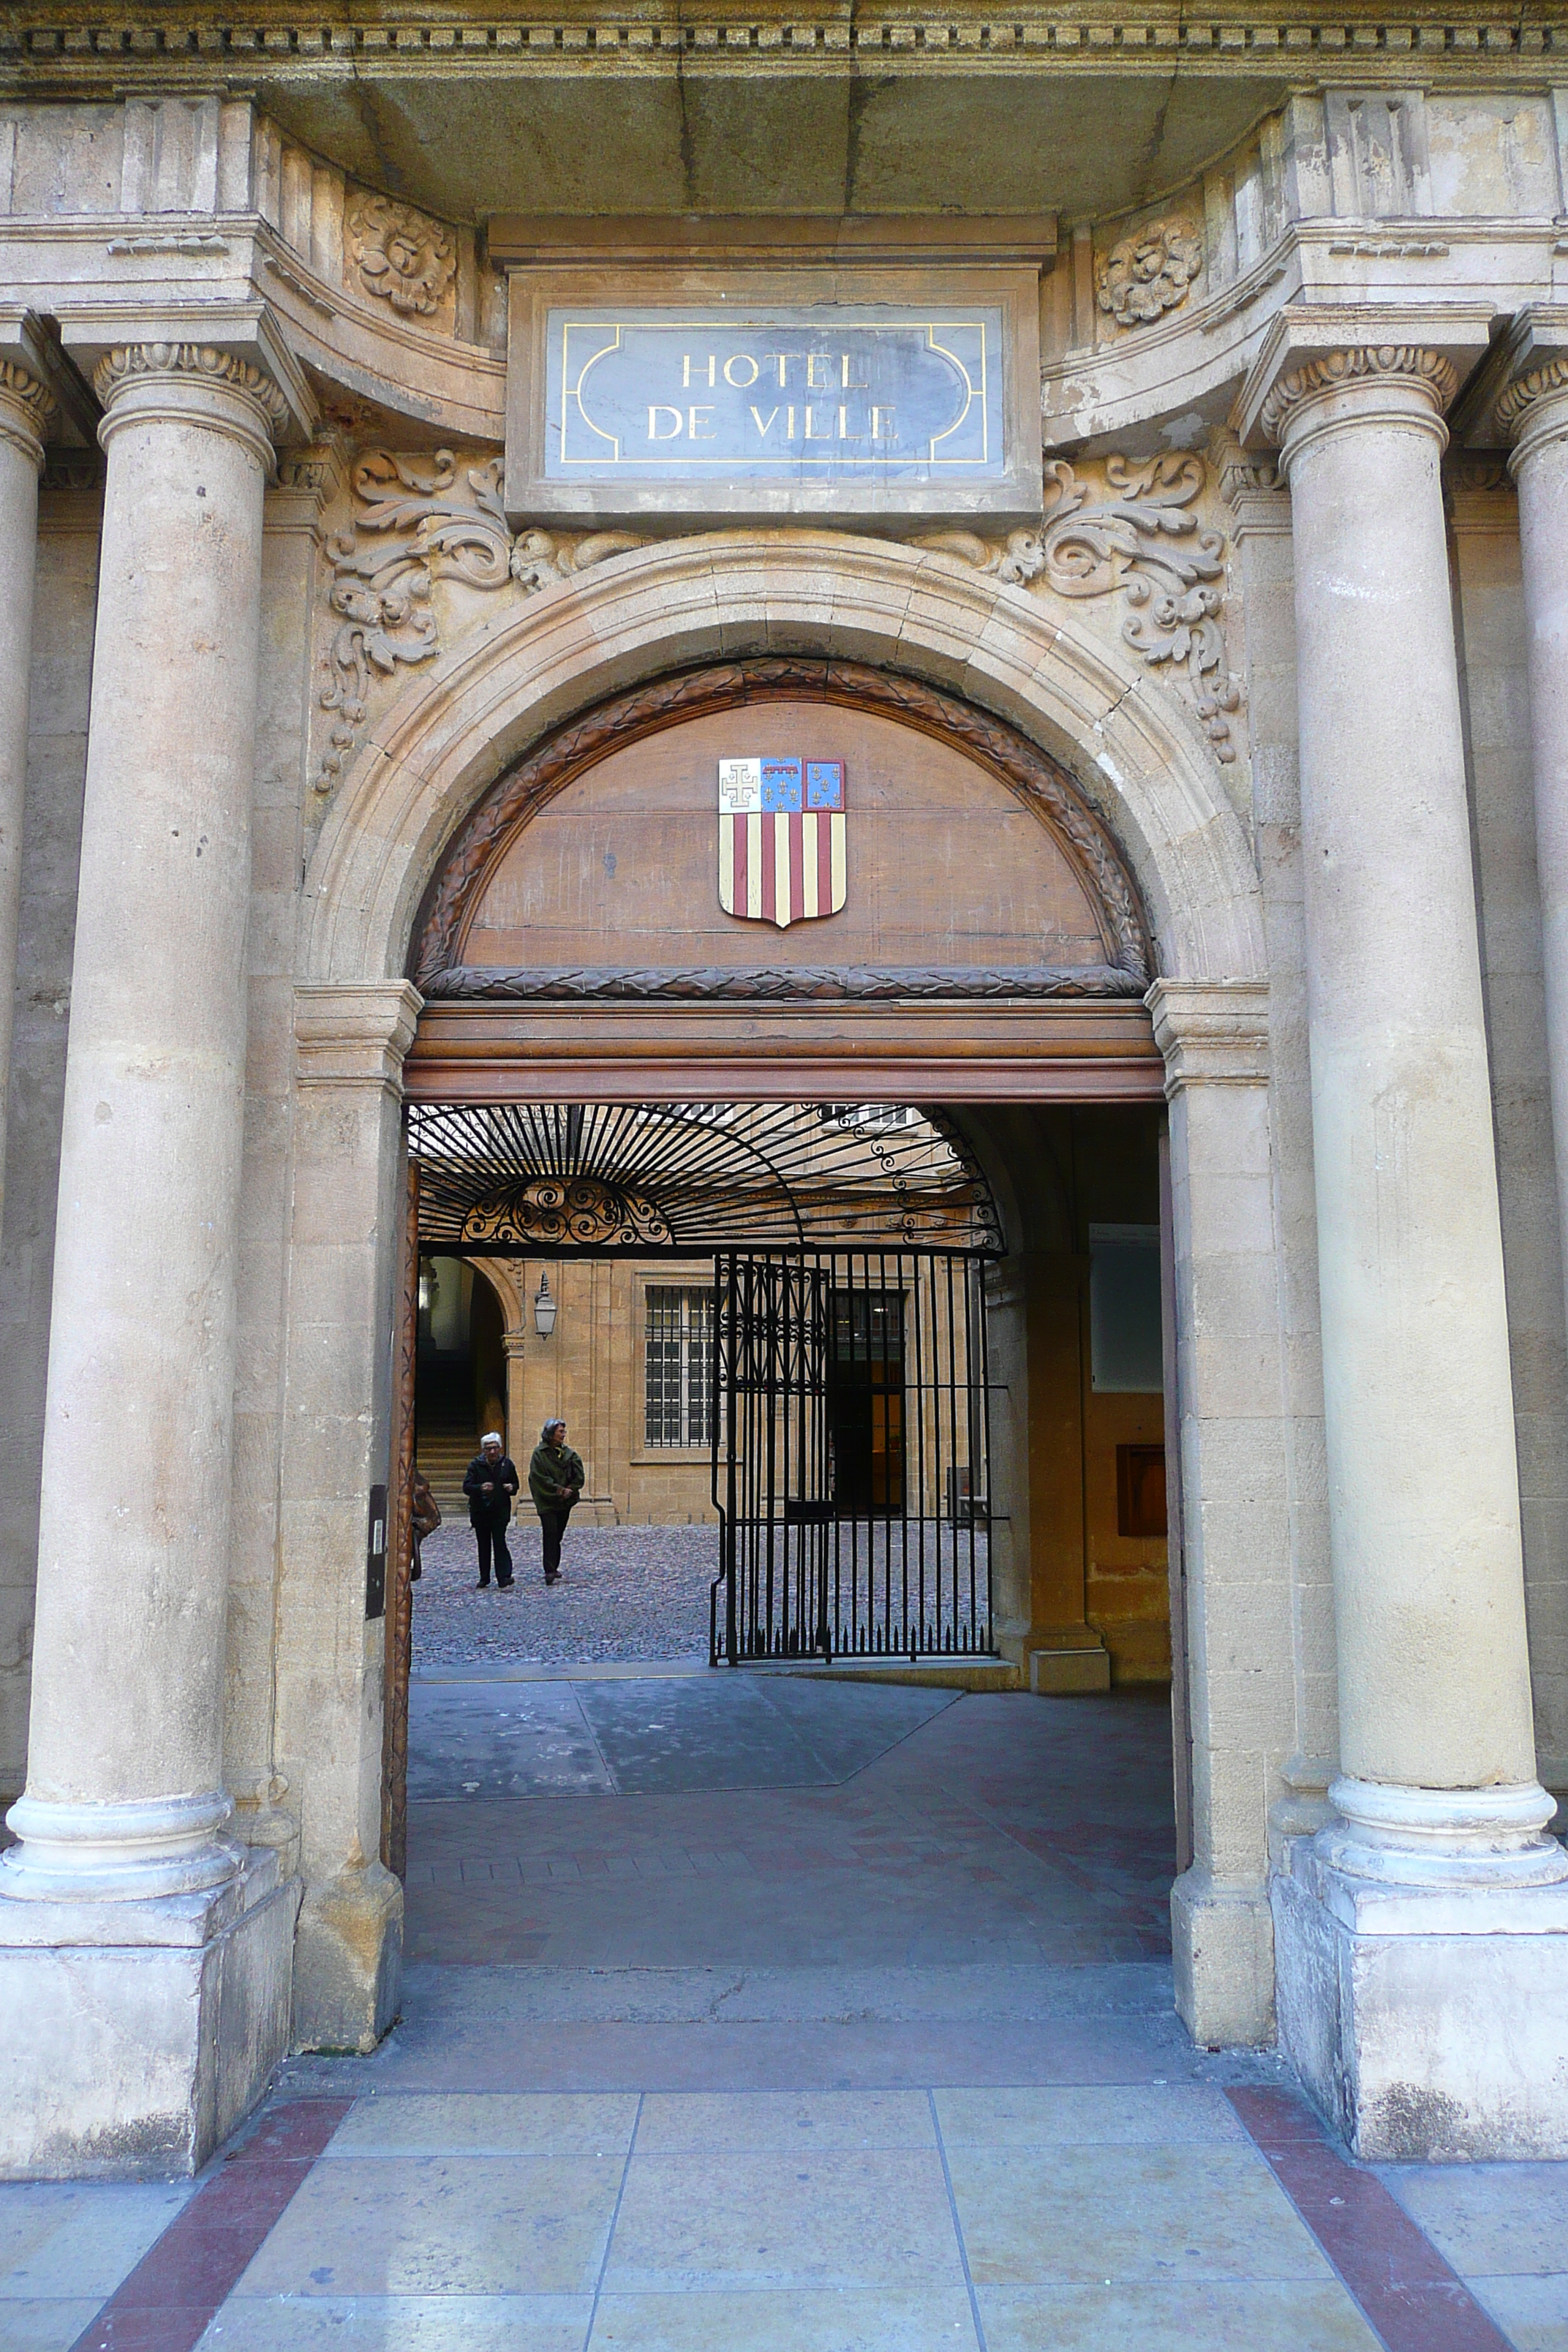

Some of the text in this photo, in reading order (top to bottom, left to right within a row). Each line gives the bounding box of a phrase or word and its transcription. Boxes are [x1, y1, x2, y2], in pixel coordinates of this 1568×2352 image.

[681, 355, 868, 388] HOTEL
[647, 406, 899, 440] DE VILLE
